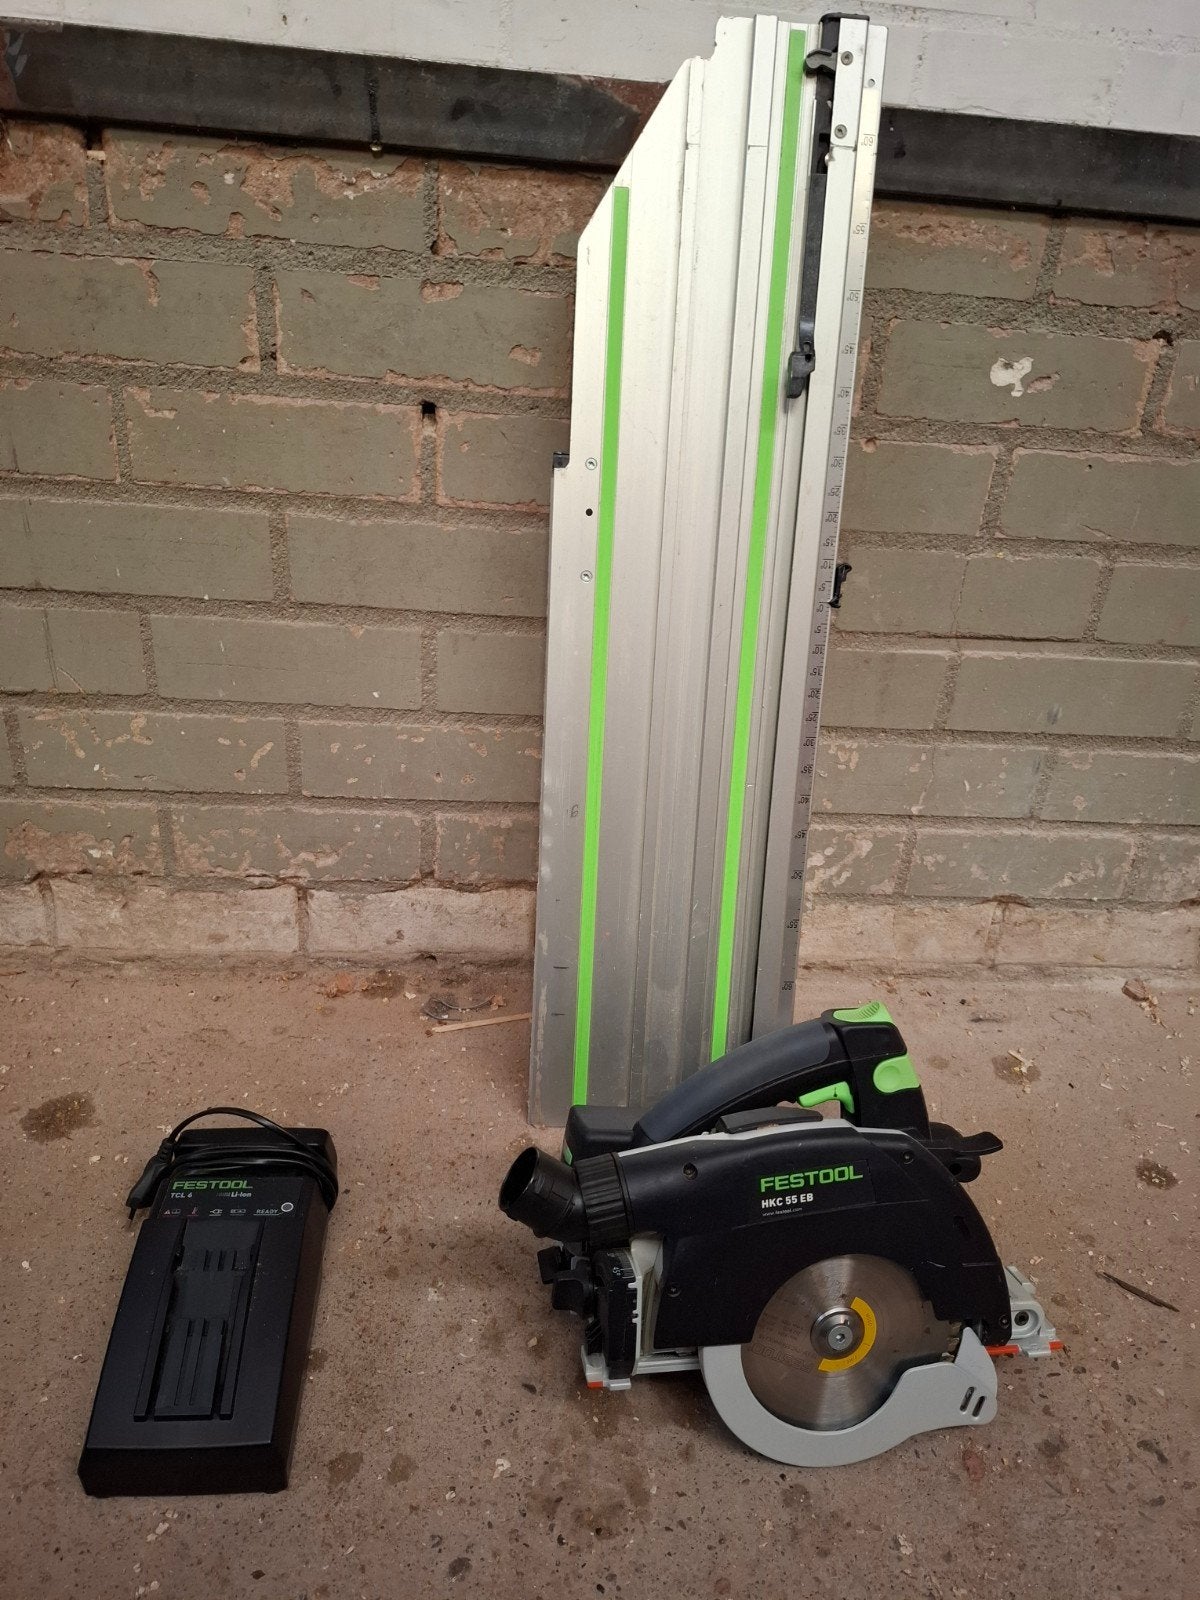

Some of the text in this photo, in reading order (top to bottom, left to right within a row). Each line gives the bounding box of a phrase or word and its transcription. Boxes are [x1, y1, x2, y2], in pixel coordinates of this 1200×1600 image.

[172, 1180, 253, 1190] FESTOOL
[760, 1165, 864, 1192] FESTOOL
[761, 1192, 814, 1209] HKC 55 EB
